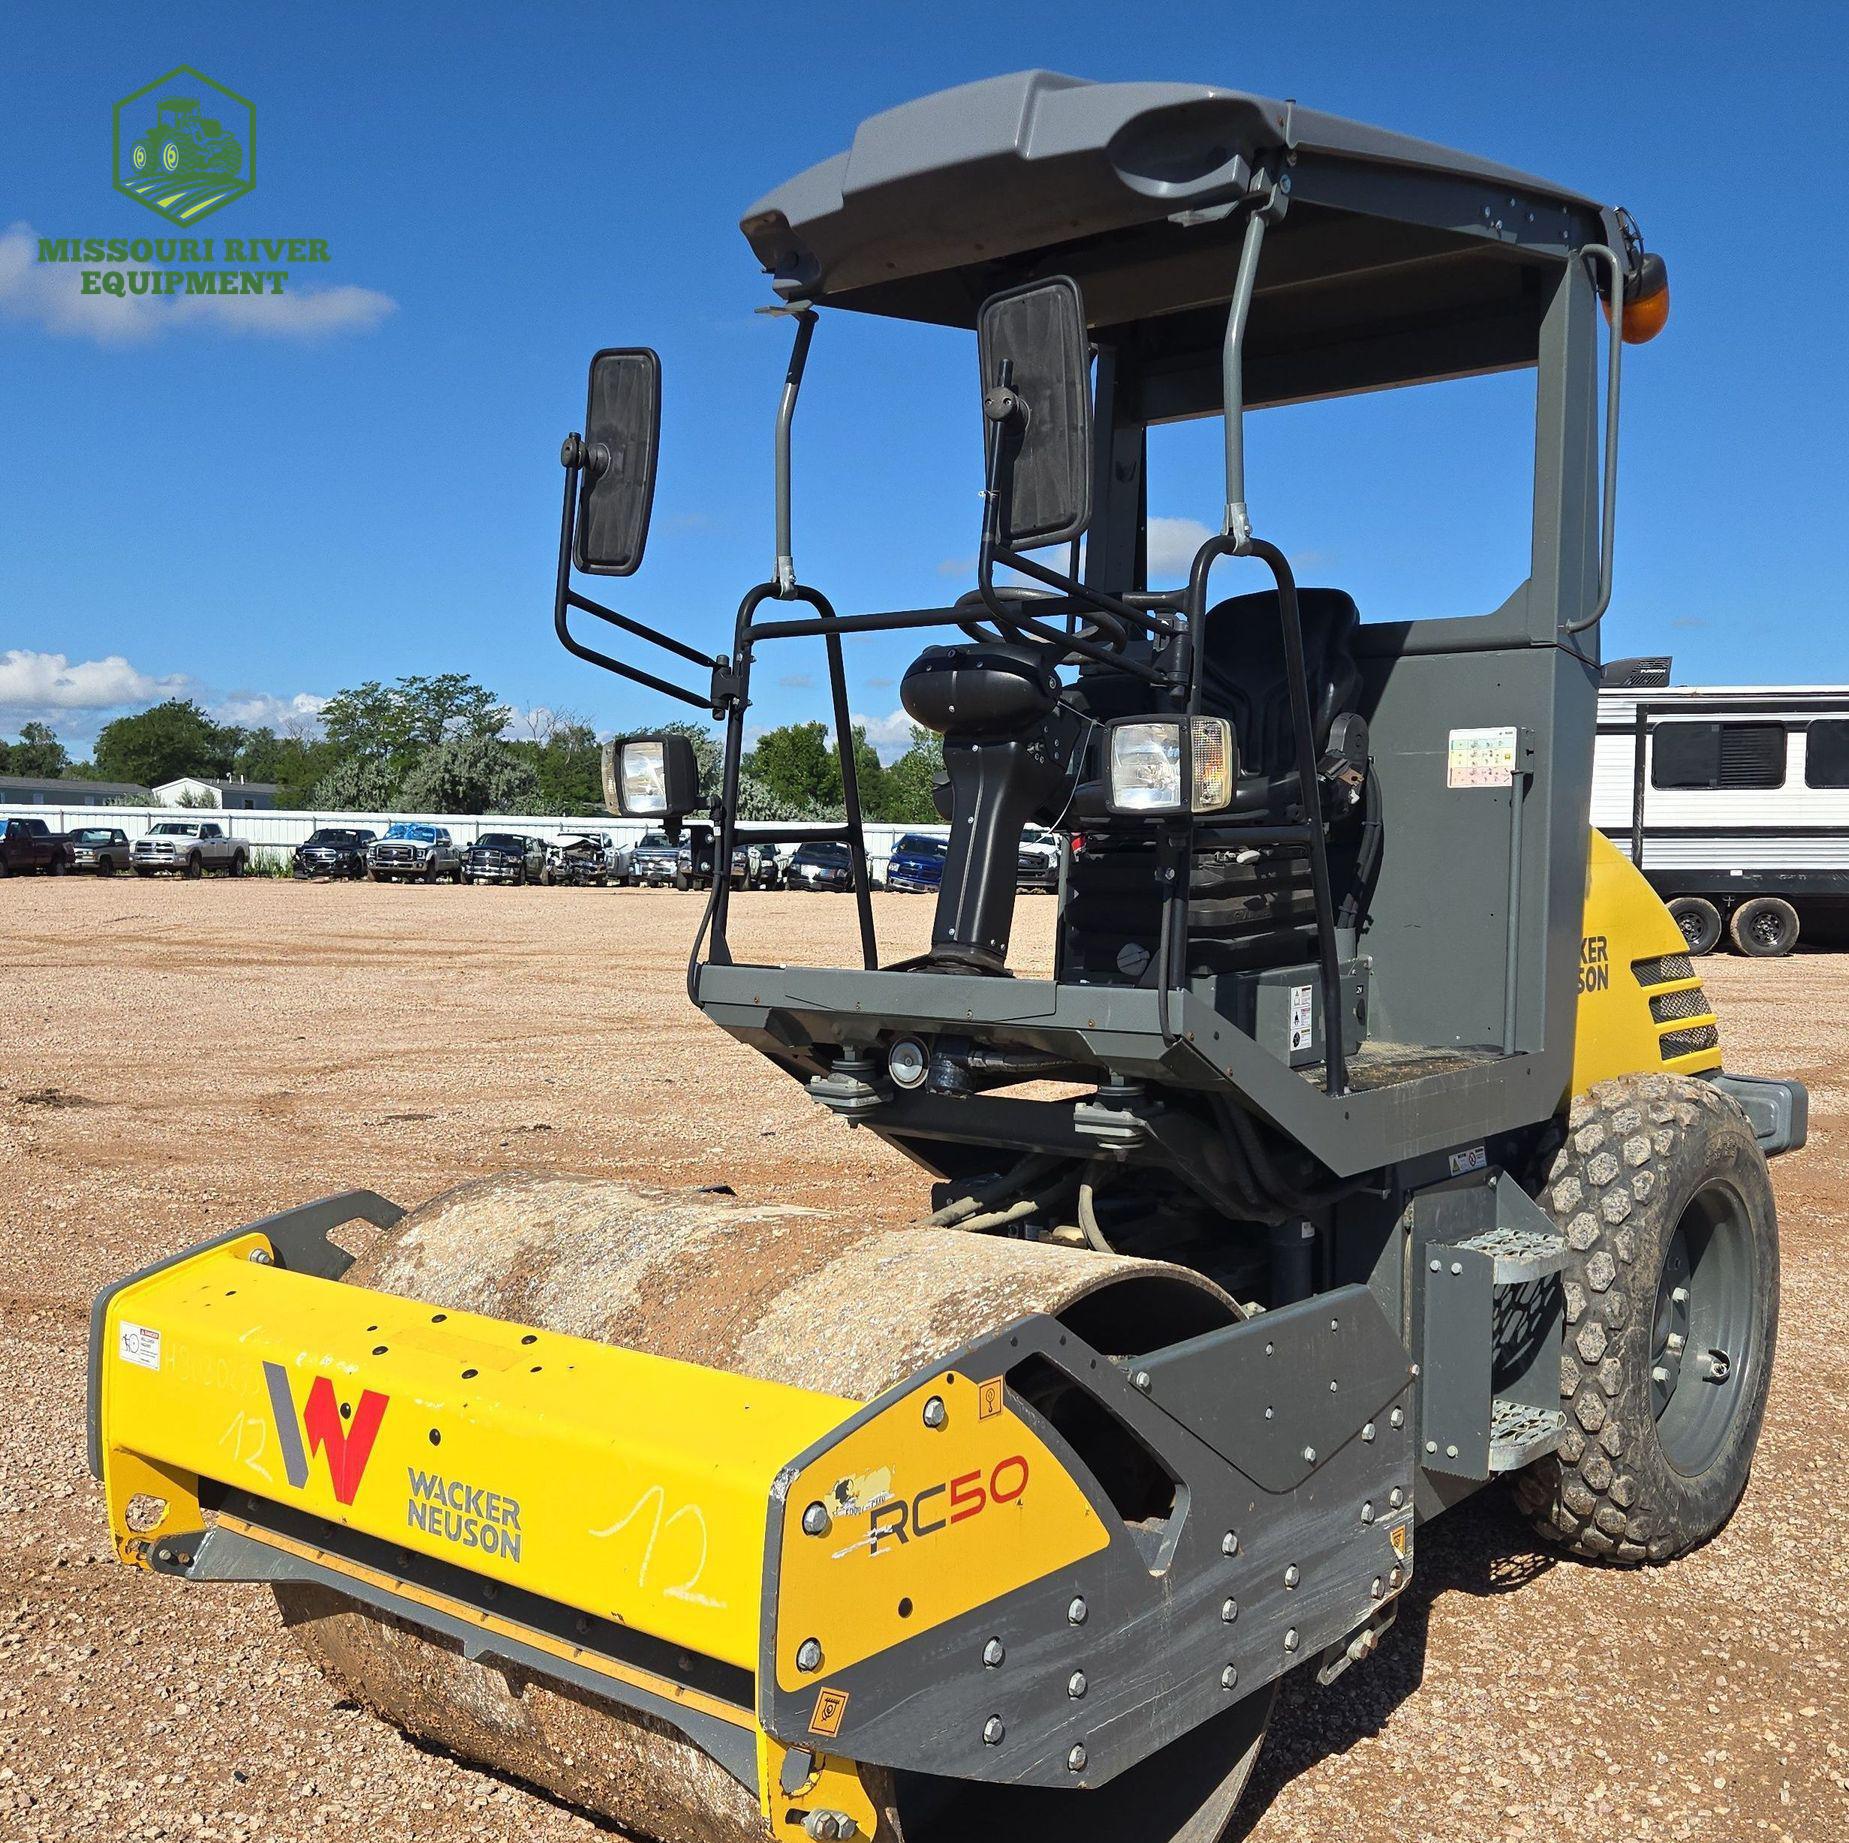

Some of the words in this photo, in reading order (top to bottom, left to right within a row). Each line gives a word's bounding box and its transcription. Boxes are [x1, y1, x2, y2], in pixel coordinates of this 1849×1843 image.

[218, 1411, 272, 1481] 12
[407, 1466, 522, 1531] WACKER
[407, 1498, 522, 1564] NEUSON
[870, 1455, 1029, 1554] RC50
[588, 1485, 727, 1608] 12
